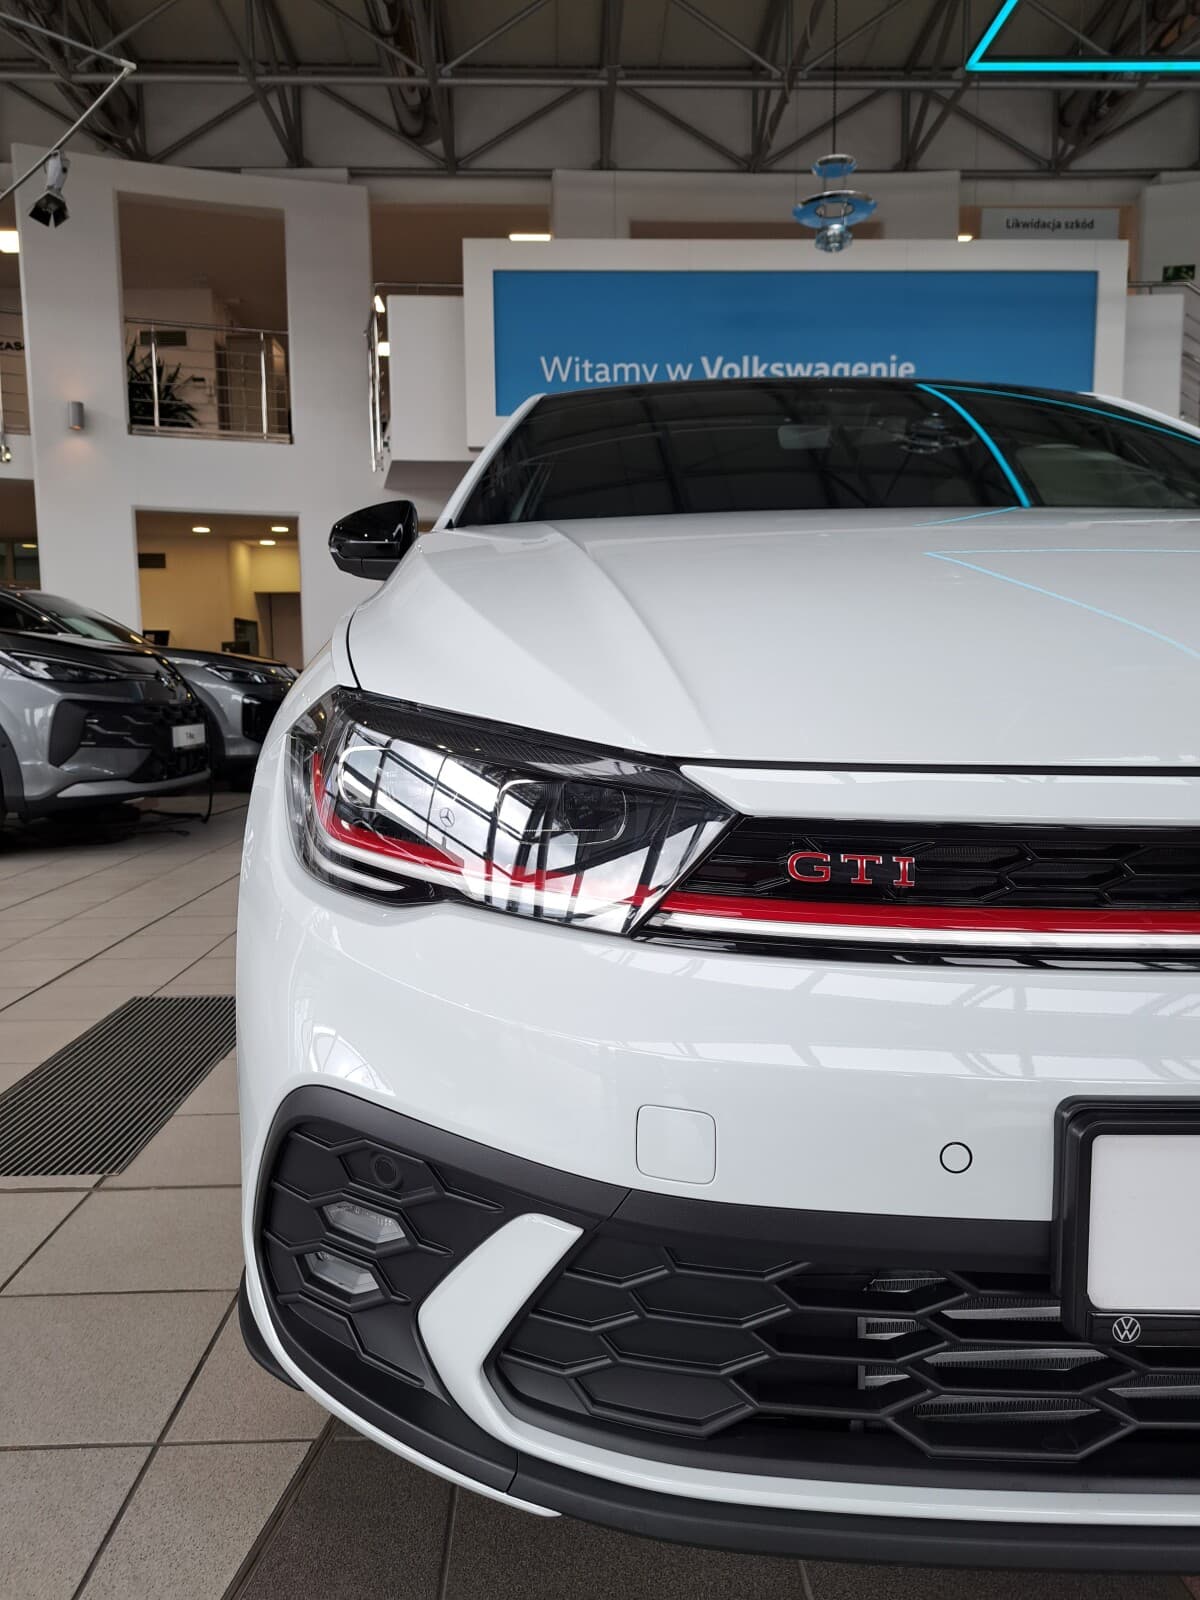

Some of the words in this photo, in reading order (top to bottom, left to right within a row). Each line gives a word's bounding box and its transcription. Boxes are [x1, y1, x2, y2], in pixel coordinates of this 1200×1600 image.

[1006, 218, 1061, 232] Likwidacja
[1064, 218, 1094, 229] szkód
[540, 356, 658, 383] Witamy
[666, 363, 693, 380] w
[701, 354, 915, 379] Volkswagenie
[787, 851, 915, 887] GTI
[1112, 1316, 1141, 1344] VW
